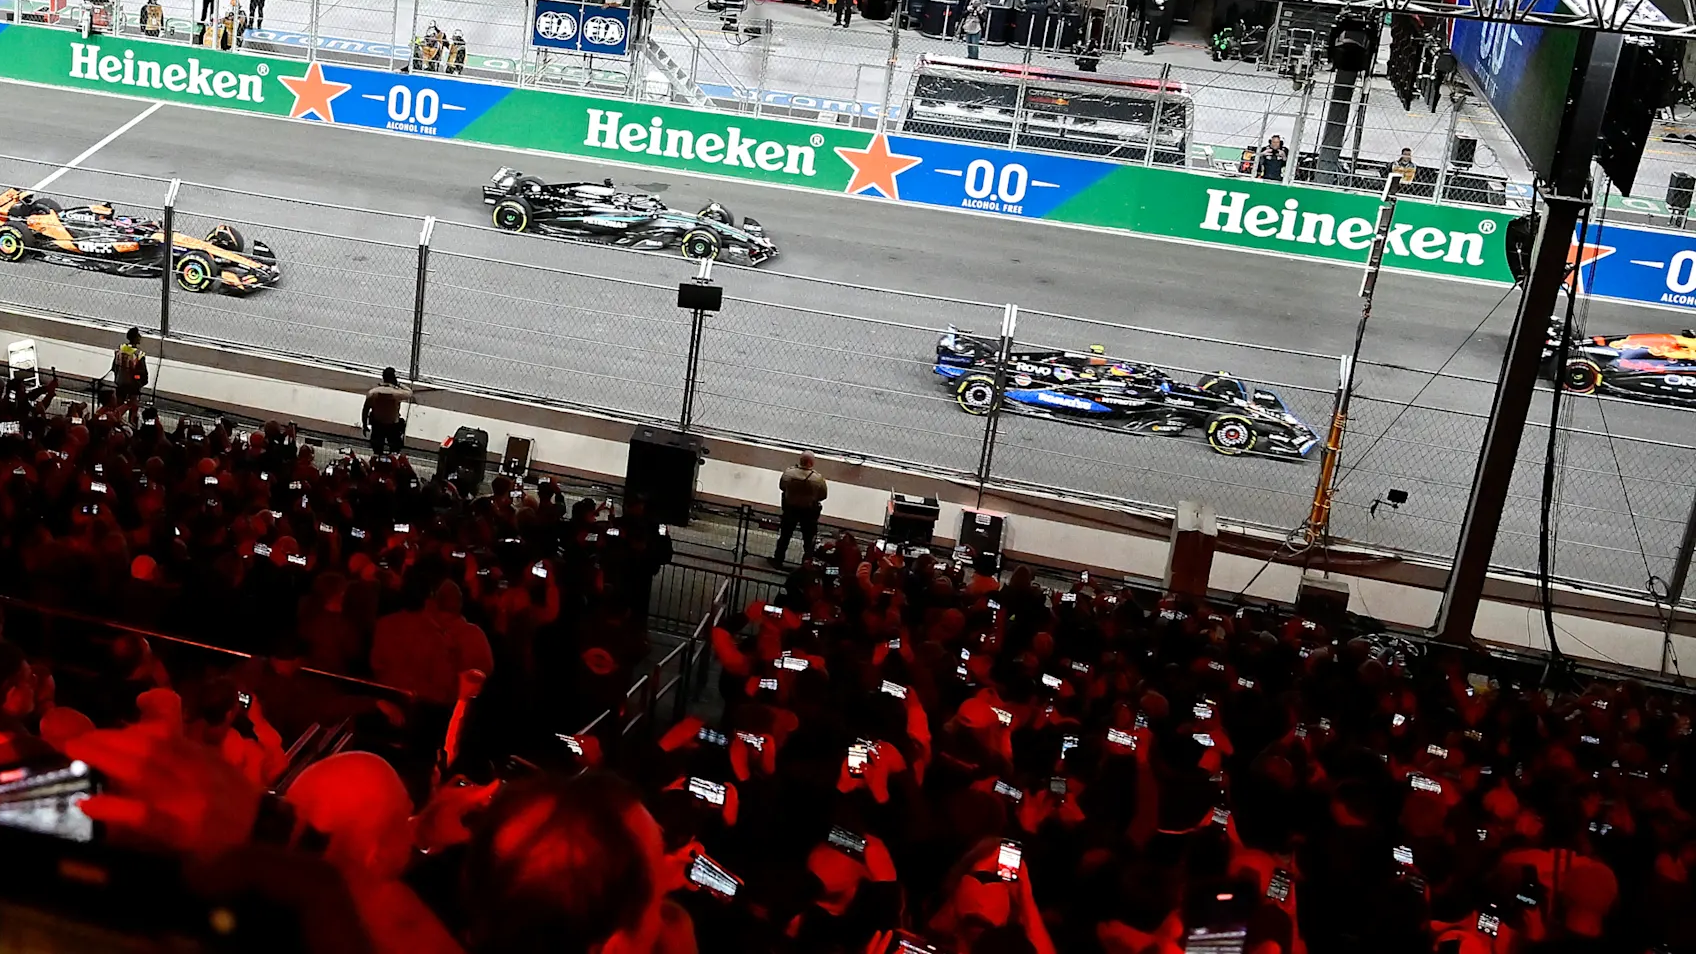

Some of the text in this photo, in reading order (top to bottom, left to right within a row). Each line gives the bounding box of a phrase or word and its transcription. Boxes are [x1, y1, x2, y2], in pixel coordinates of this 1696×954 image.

[537, 15, 577, 36] FIA
[585, 19, 624, 41] FIA
[386, 85, 440, 126] 0.0
[731, 90, 901, 118] aramc
[386, 119, 437, 135] ALCOHOL FREE
[964, 159, 1029, 204] 0.0
[961, 198, 1023, 214] ALCOHOL FREE
